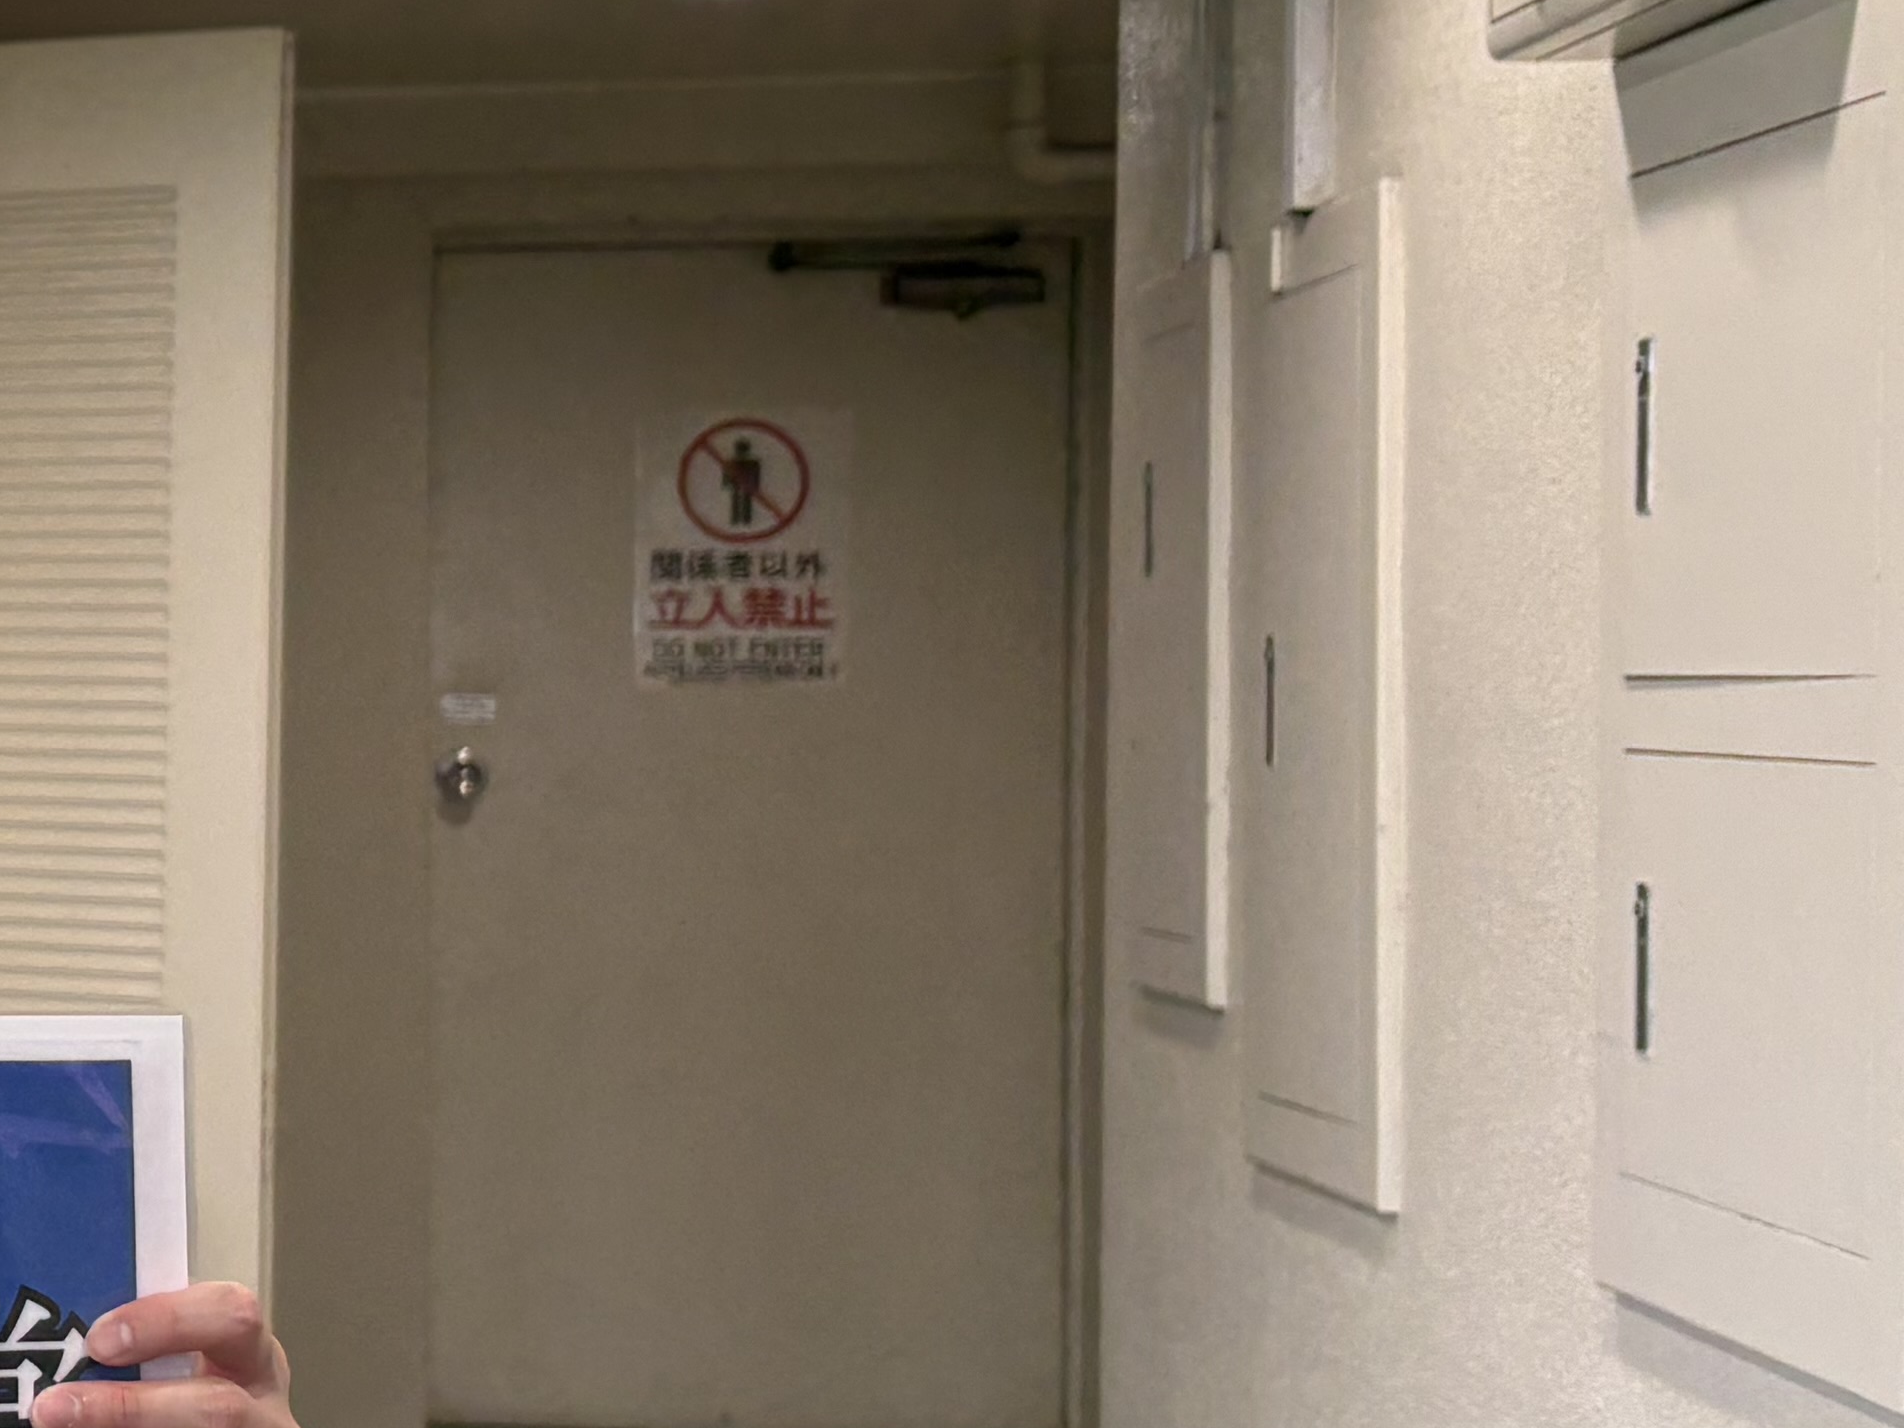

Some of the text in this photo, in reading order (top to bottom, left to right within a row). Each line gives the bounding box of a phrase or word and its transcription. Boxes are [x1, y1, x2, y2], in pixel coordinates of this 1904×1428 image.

[650, 547, 827, 582] 関係者以外
[648, 587, 834, 631] 立入禁止
